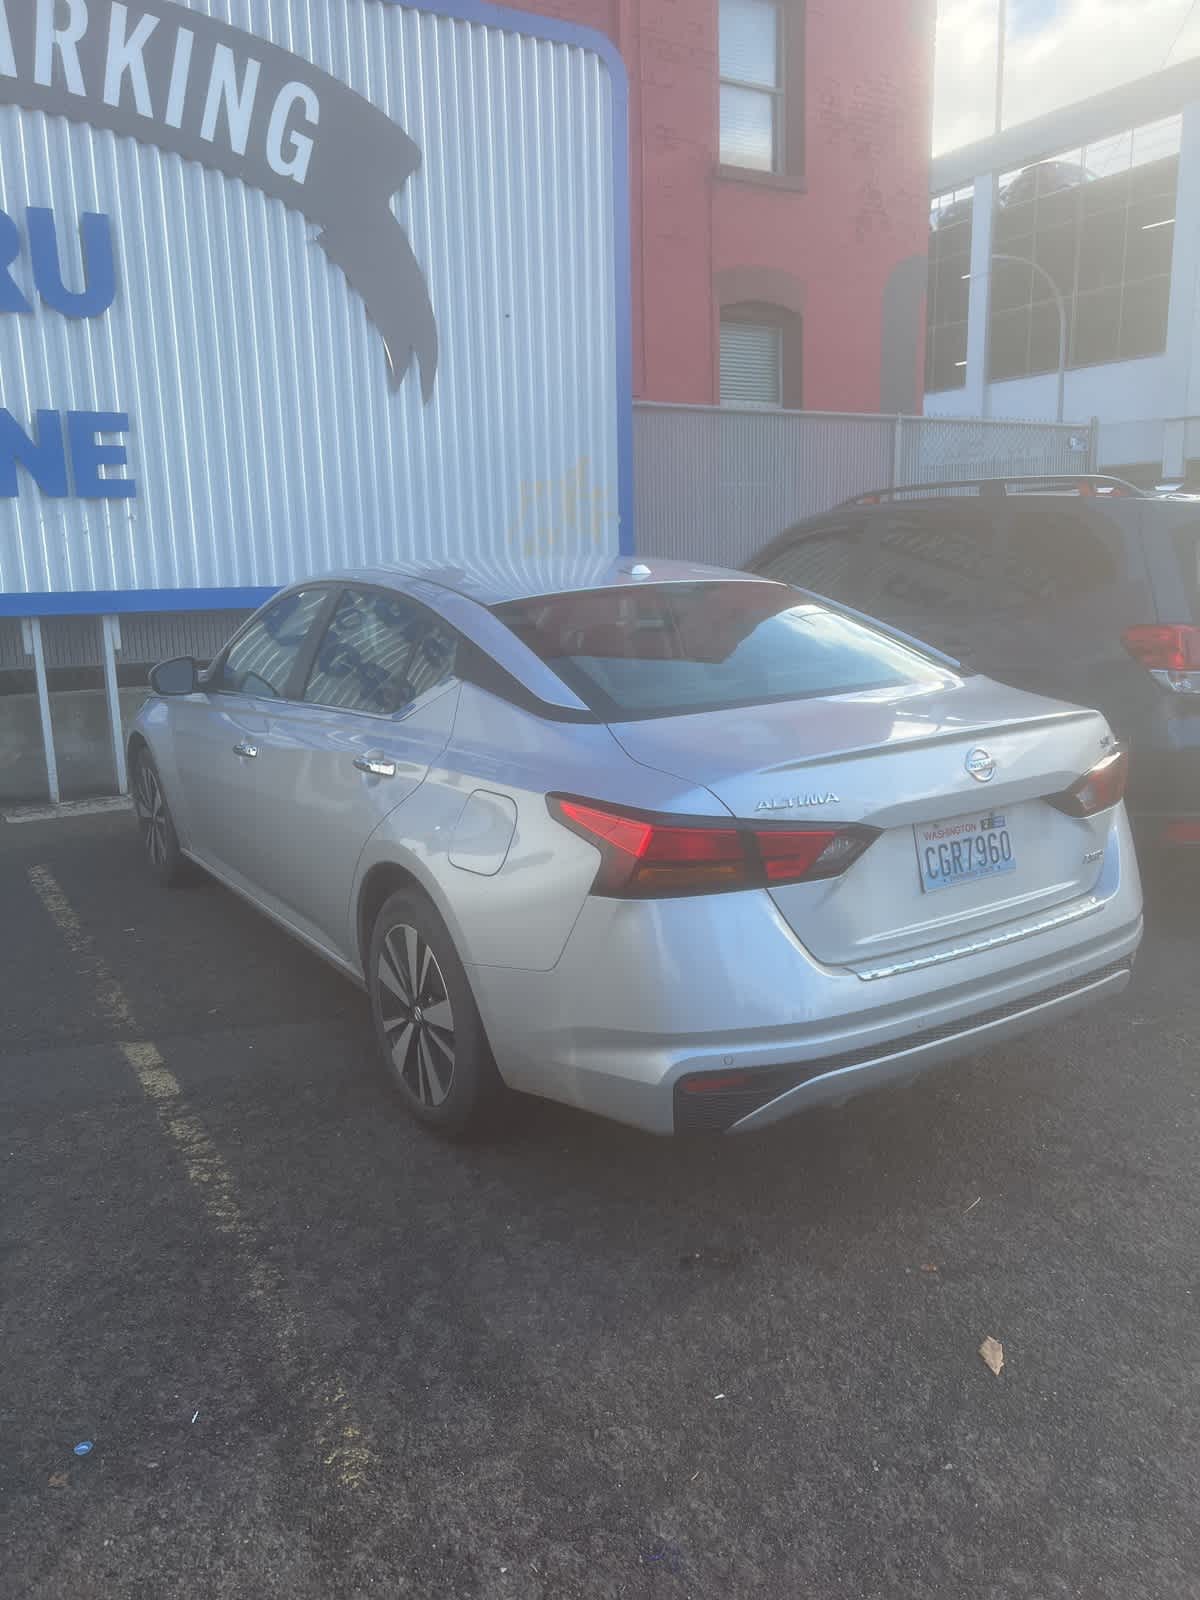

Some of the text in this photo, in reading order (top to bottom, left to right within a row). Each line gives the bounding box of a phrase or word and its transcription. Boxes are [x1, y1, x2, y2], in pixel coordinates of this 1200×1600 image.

[0, 407, 137, 498] NE
[754, 791, 840, 812] ALTIMA
[923, 823, 977, 841] WASHINGTON
[925, 830, 1012, 879] CGR7960
